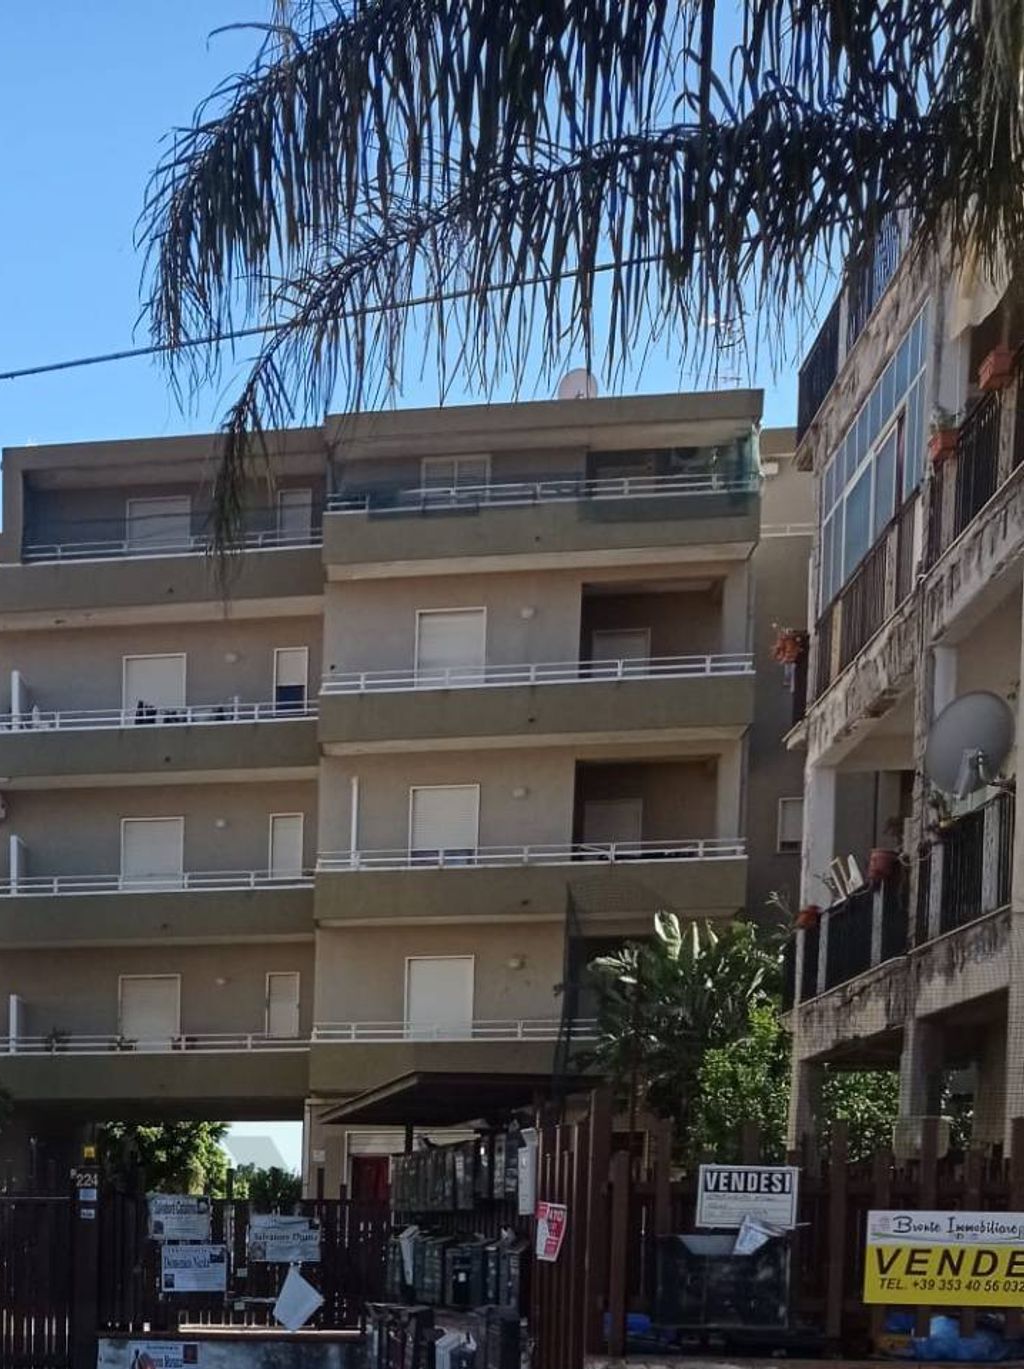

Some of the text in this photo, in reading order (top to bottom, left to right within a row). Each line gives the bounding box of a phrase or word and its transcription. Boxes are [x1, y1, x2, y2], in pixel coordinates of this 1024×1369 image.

[76, 1173, 98, 1187] 224
[706, 1172, 791, 1192] VENDESI
[946, 1216, 1017, 1234] Immobiliare
[876, 1248, 1024, 1277] VENDE
[913, 1279, 936, 1290] +39
[938, 1279, 961, 1291] 353
[965, 1280, 981, 1292] 40
[984, 1280, 1000, 1292] 56
